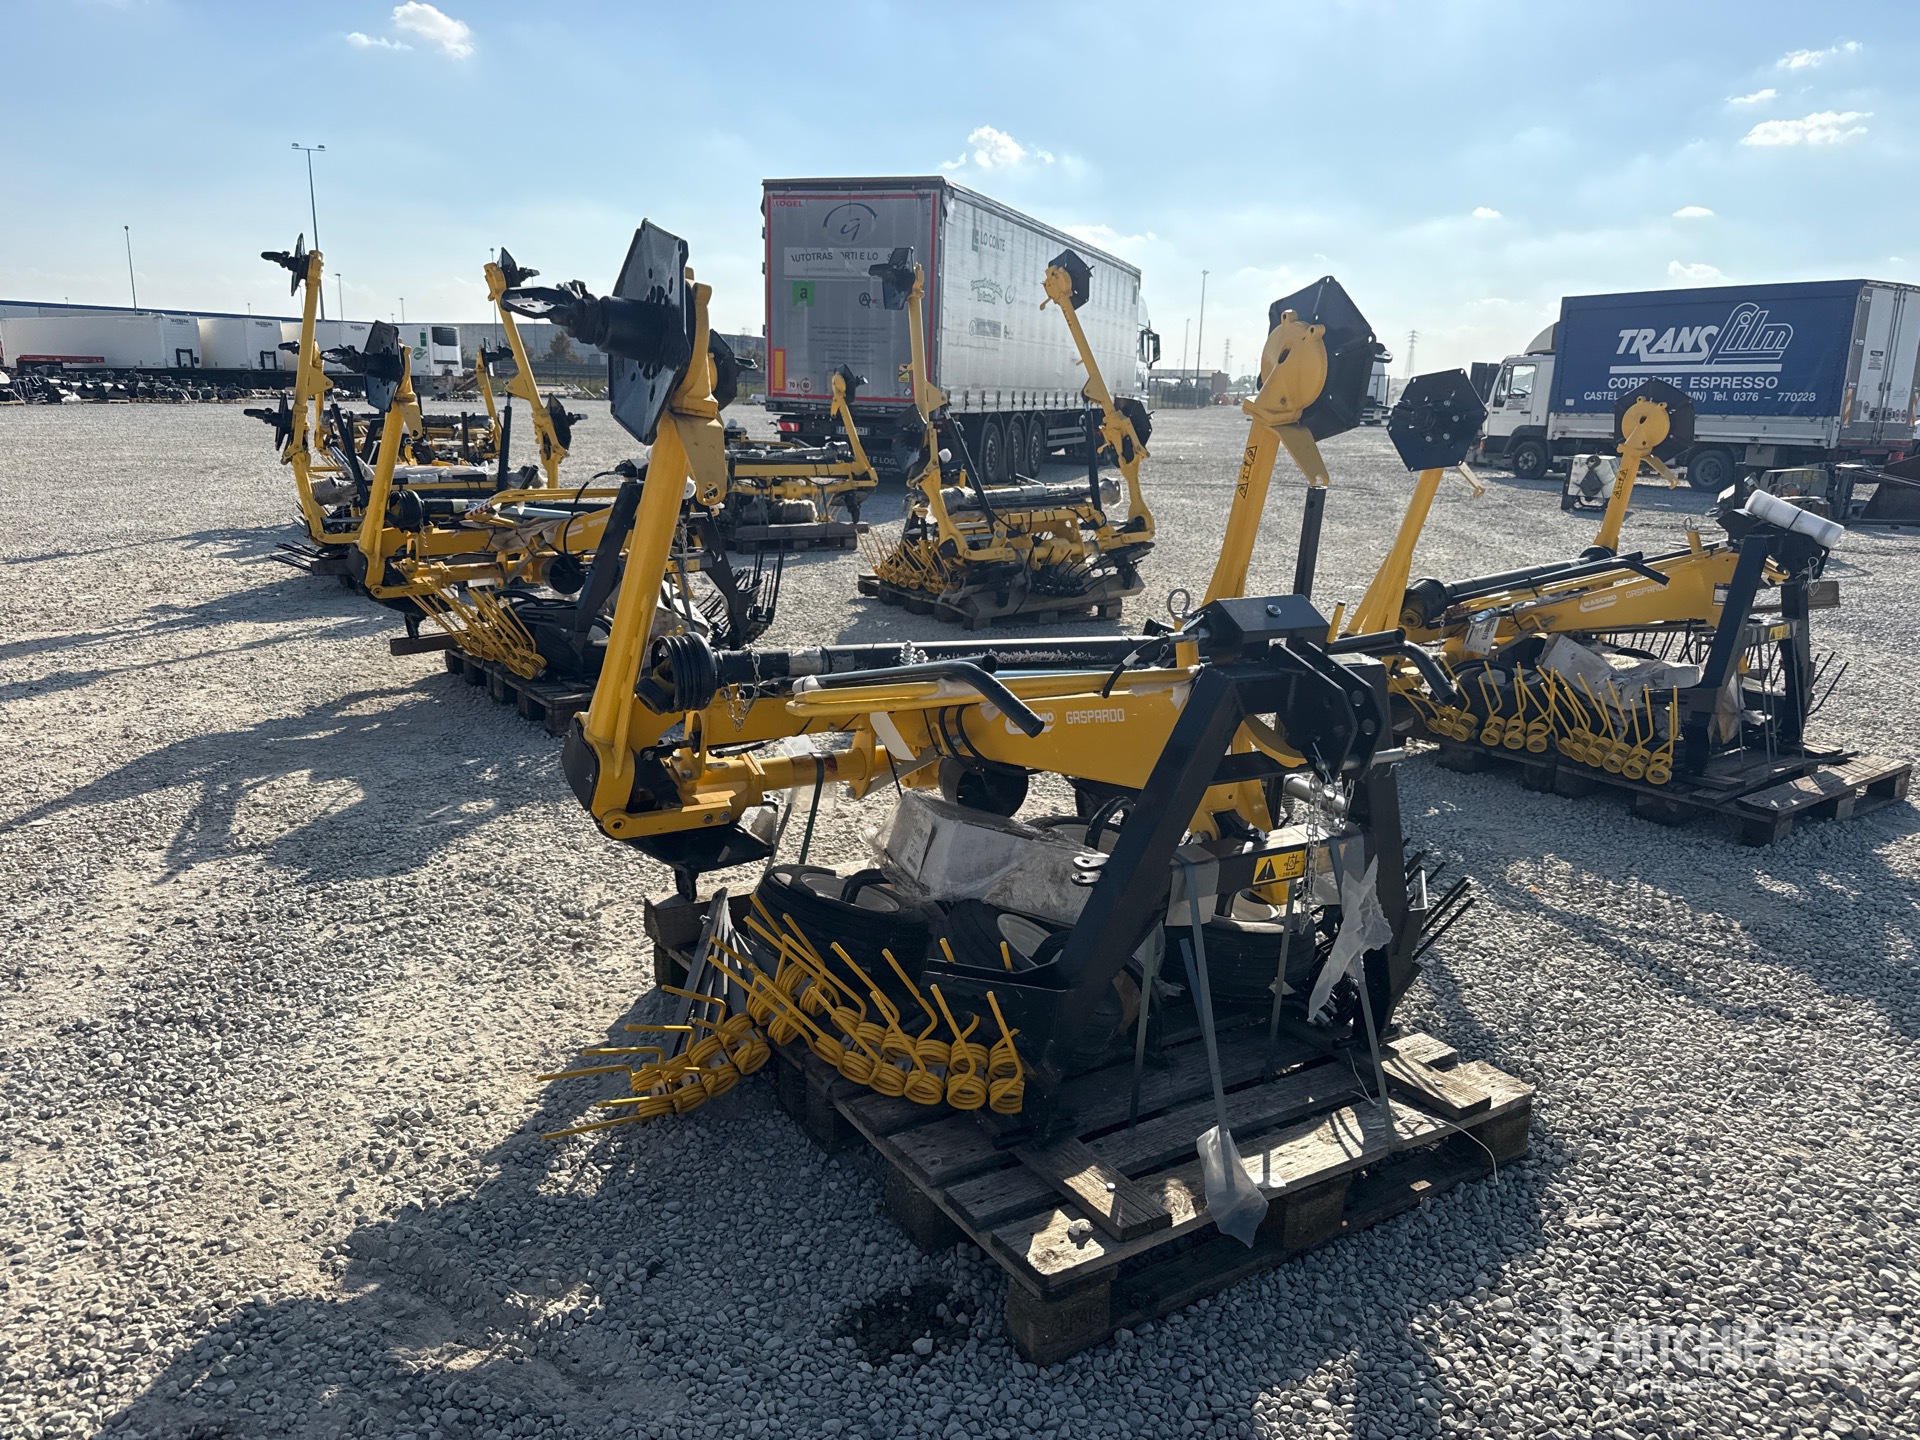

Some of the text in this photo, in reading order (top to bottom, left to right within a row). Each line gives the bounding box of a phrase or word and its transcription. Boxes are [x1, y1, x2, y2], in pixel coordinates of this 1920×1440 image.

[1689, 376, 1778, 390] ESPRESSO
[1583, 391, 1619, 401] CASTEL
[1712, 391, 1728, 402] Tel.
[1732, 391, 1759, 402] 0376
[1777, 391, 1817, 403] 770228
[1583, 594, 1617, 607] MASCHIO
[1065, 708, 1126, 725] GASPARDO
